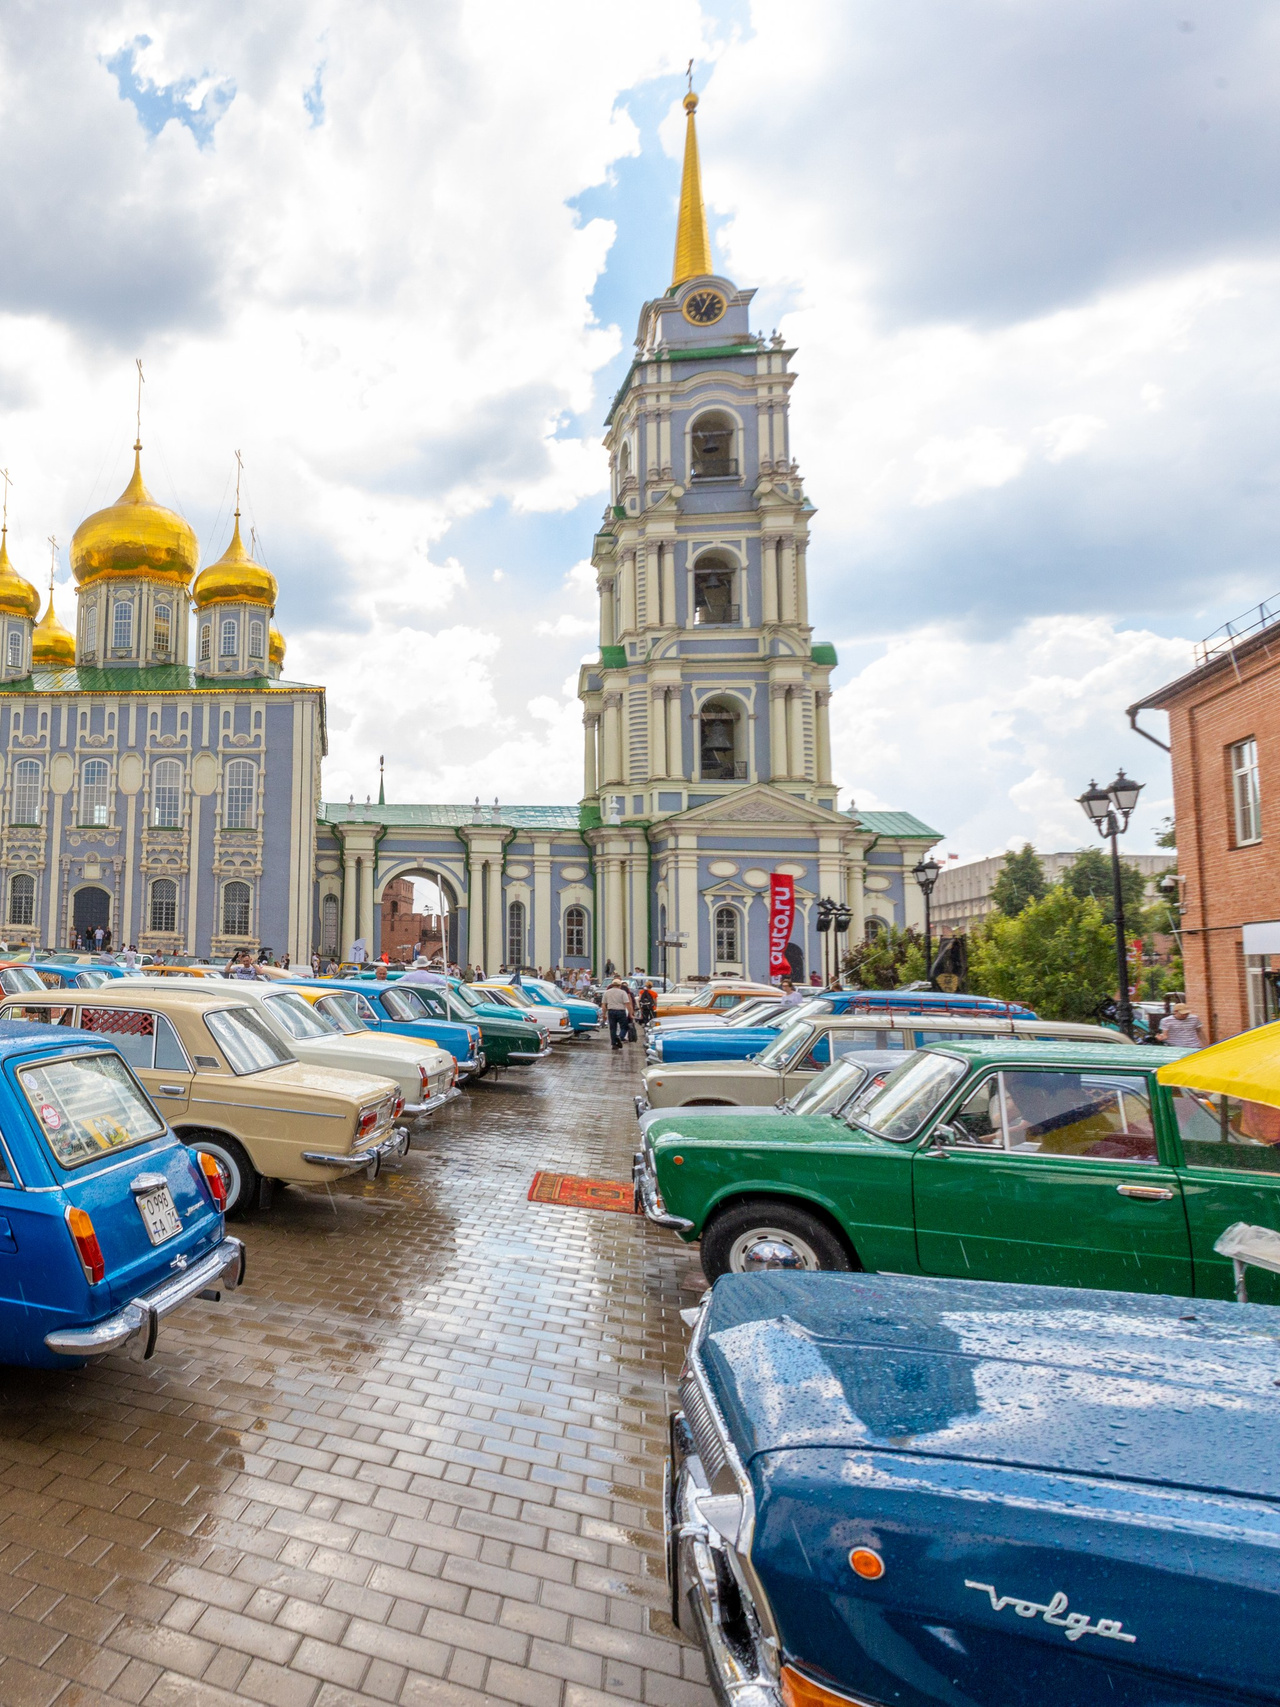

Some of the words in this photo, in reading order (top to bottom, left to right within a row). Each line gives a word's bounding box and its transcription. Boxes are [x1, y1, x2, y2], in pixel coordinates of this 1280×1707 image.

[770, 886, 791, 965] auto.ru
[167, 1211, 177, 1226] 71
[964, 1579, 1137, 1642] Volga
